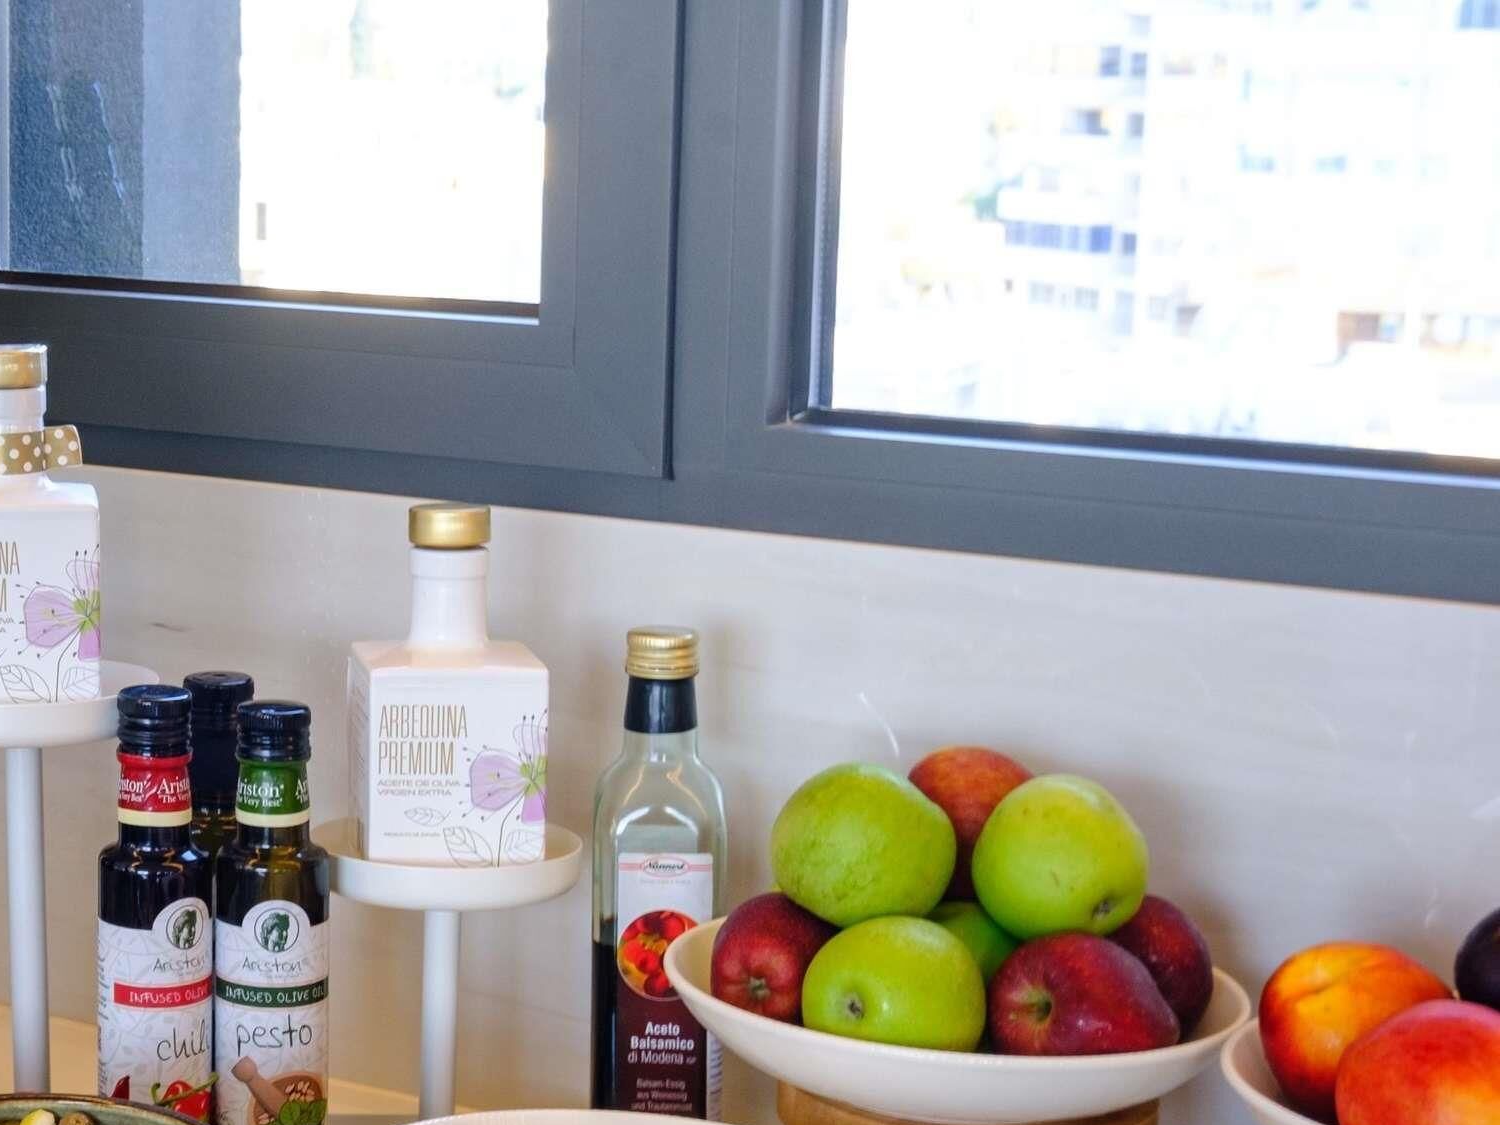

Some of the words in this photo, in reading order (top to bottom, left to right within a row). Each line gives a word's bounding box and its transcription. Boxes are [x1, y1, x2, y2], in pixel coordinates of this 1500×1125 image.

[378, 703, 468, 739] ARBEQUINA
[377, 740, 455, 777] PREMIUM
[377, 778, 413, 787] ACEITE
[414, 779, 430, 787] DE
[431, 778, 460, 787] OLIVA
[377, 788, 416, 797] VIRGEN
[418, 788, 452, 797] EXTRA
[129, 990, 181, 1005] INFUSED
[225, 985, 273, 1004] INFUSED
[276, 988, 310, 1004] OLIVE
[236, 1013, 313, 1057] pesto
[644, 1021, 681, 1037] Aceto
[630, 1035, 695, 1051] Balsamico
[627, 1050, 638, 1064] di
[640, 1050, 684, 1065] Modena
